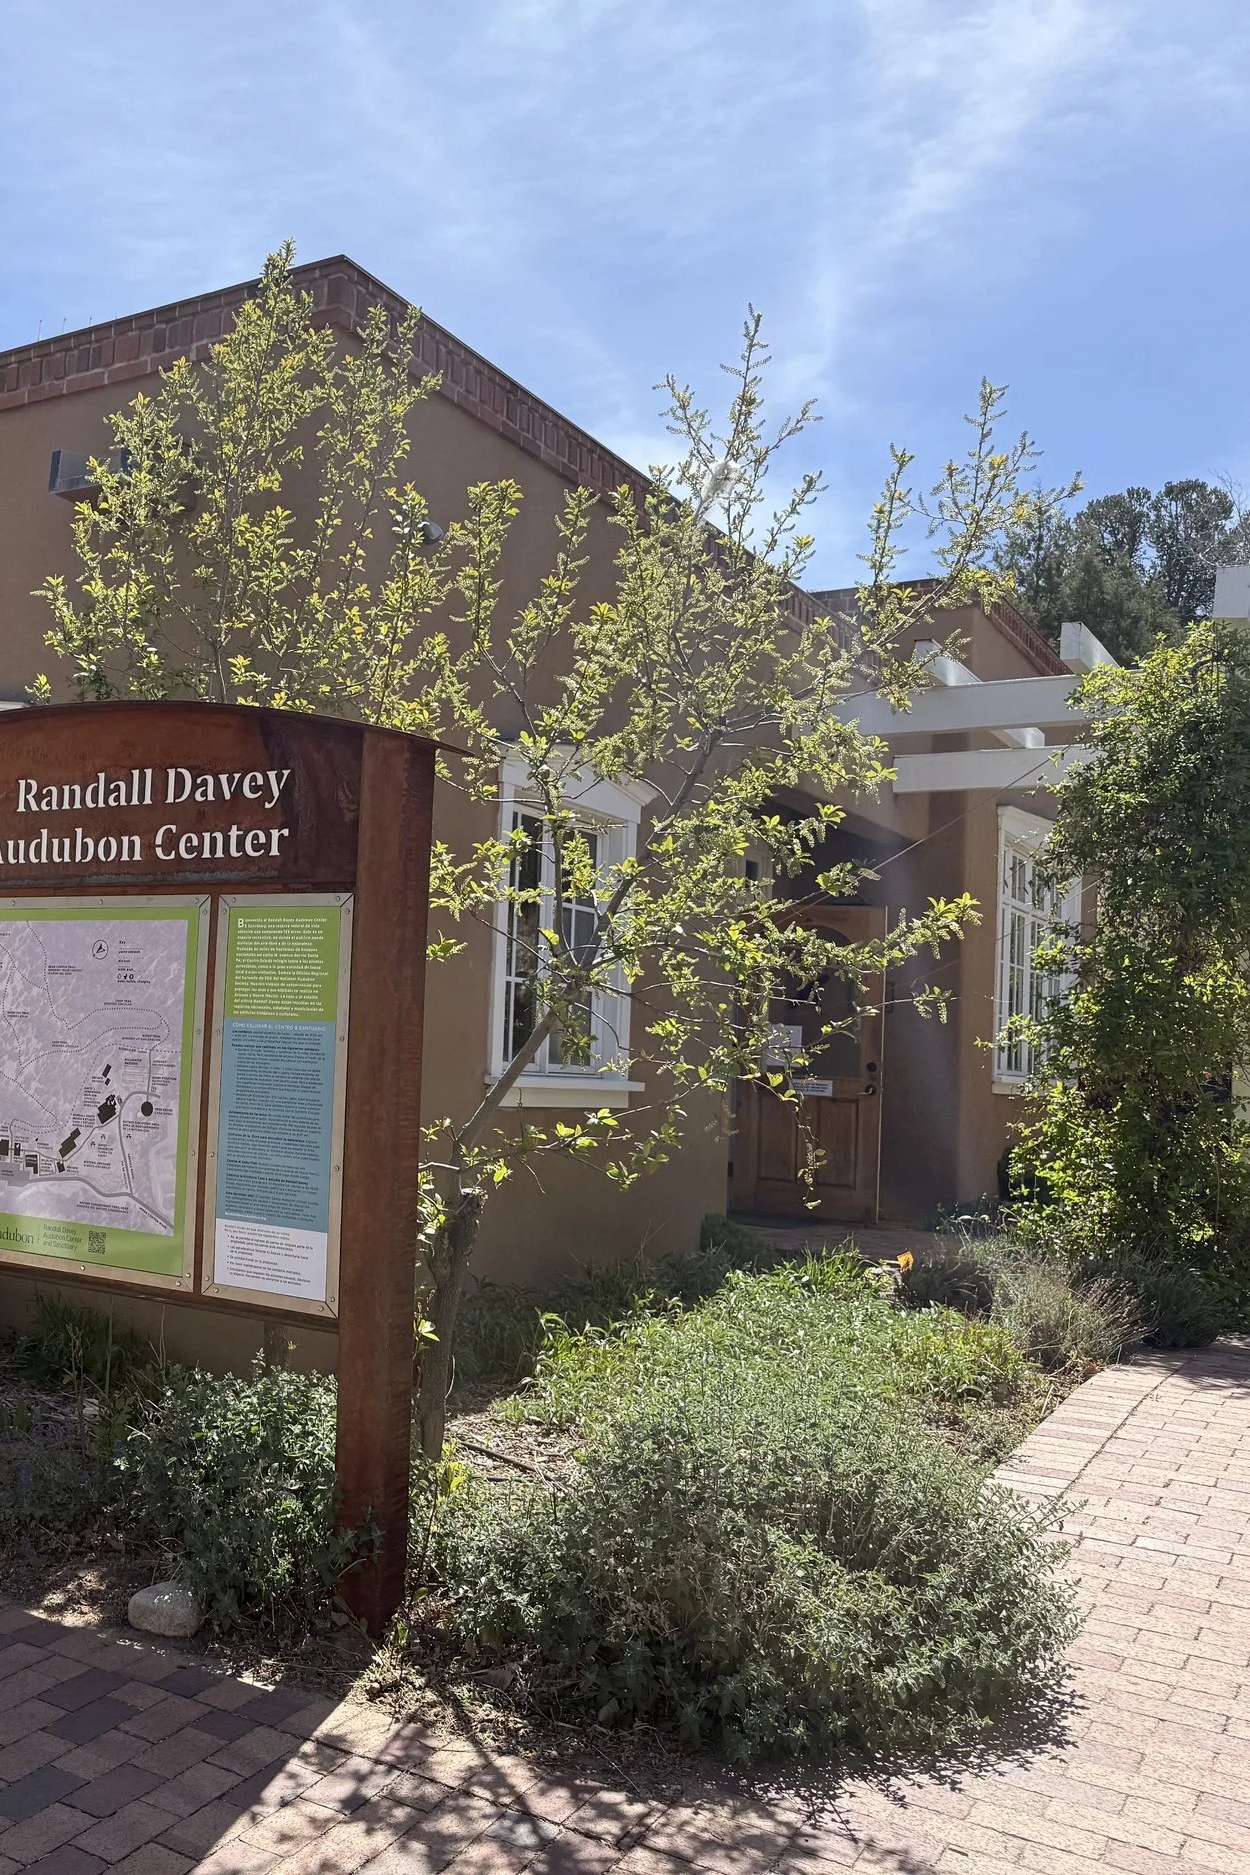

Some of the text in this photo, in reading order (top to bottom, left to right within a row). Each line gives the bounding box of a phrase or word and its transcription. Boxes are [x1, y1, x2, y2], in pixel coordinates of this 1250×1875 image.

[16, 767, 291, 812] Randall Davey
[154, 824, 289, 860] Center
[44, 1224, 77, 1236] Randall Davey
[43, 1232, 66, 1242] Audubon
[53, 1241, 78, 1251] Sanctuary
